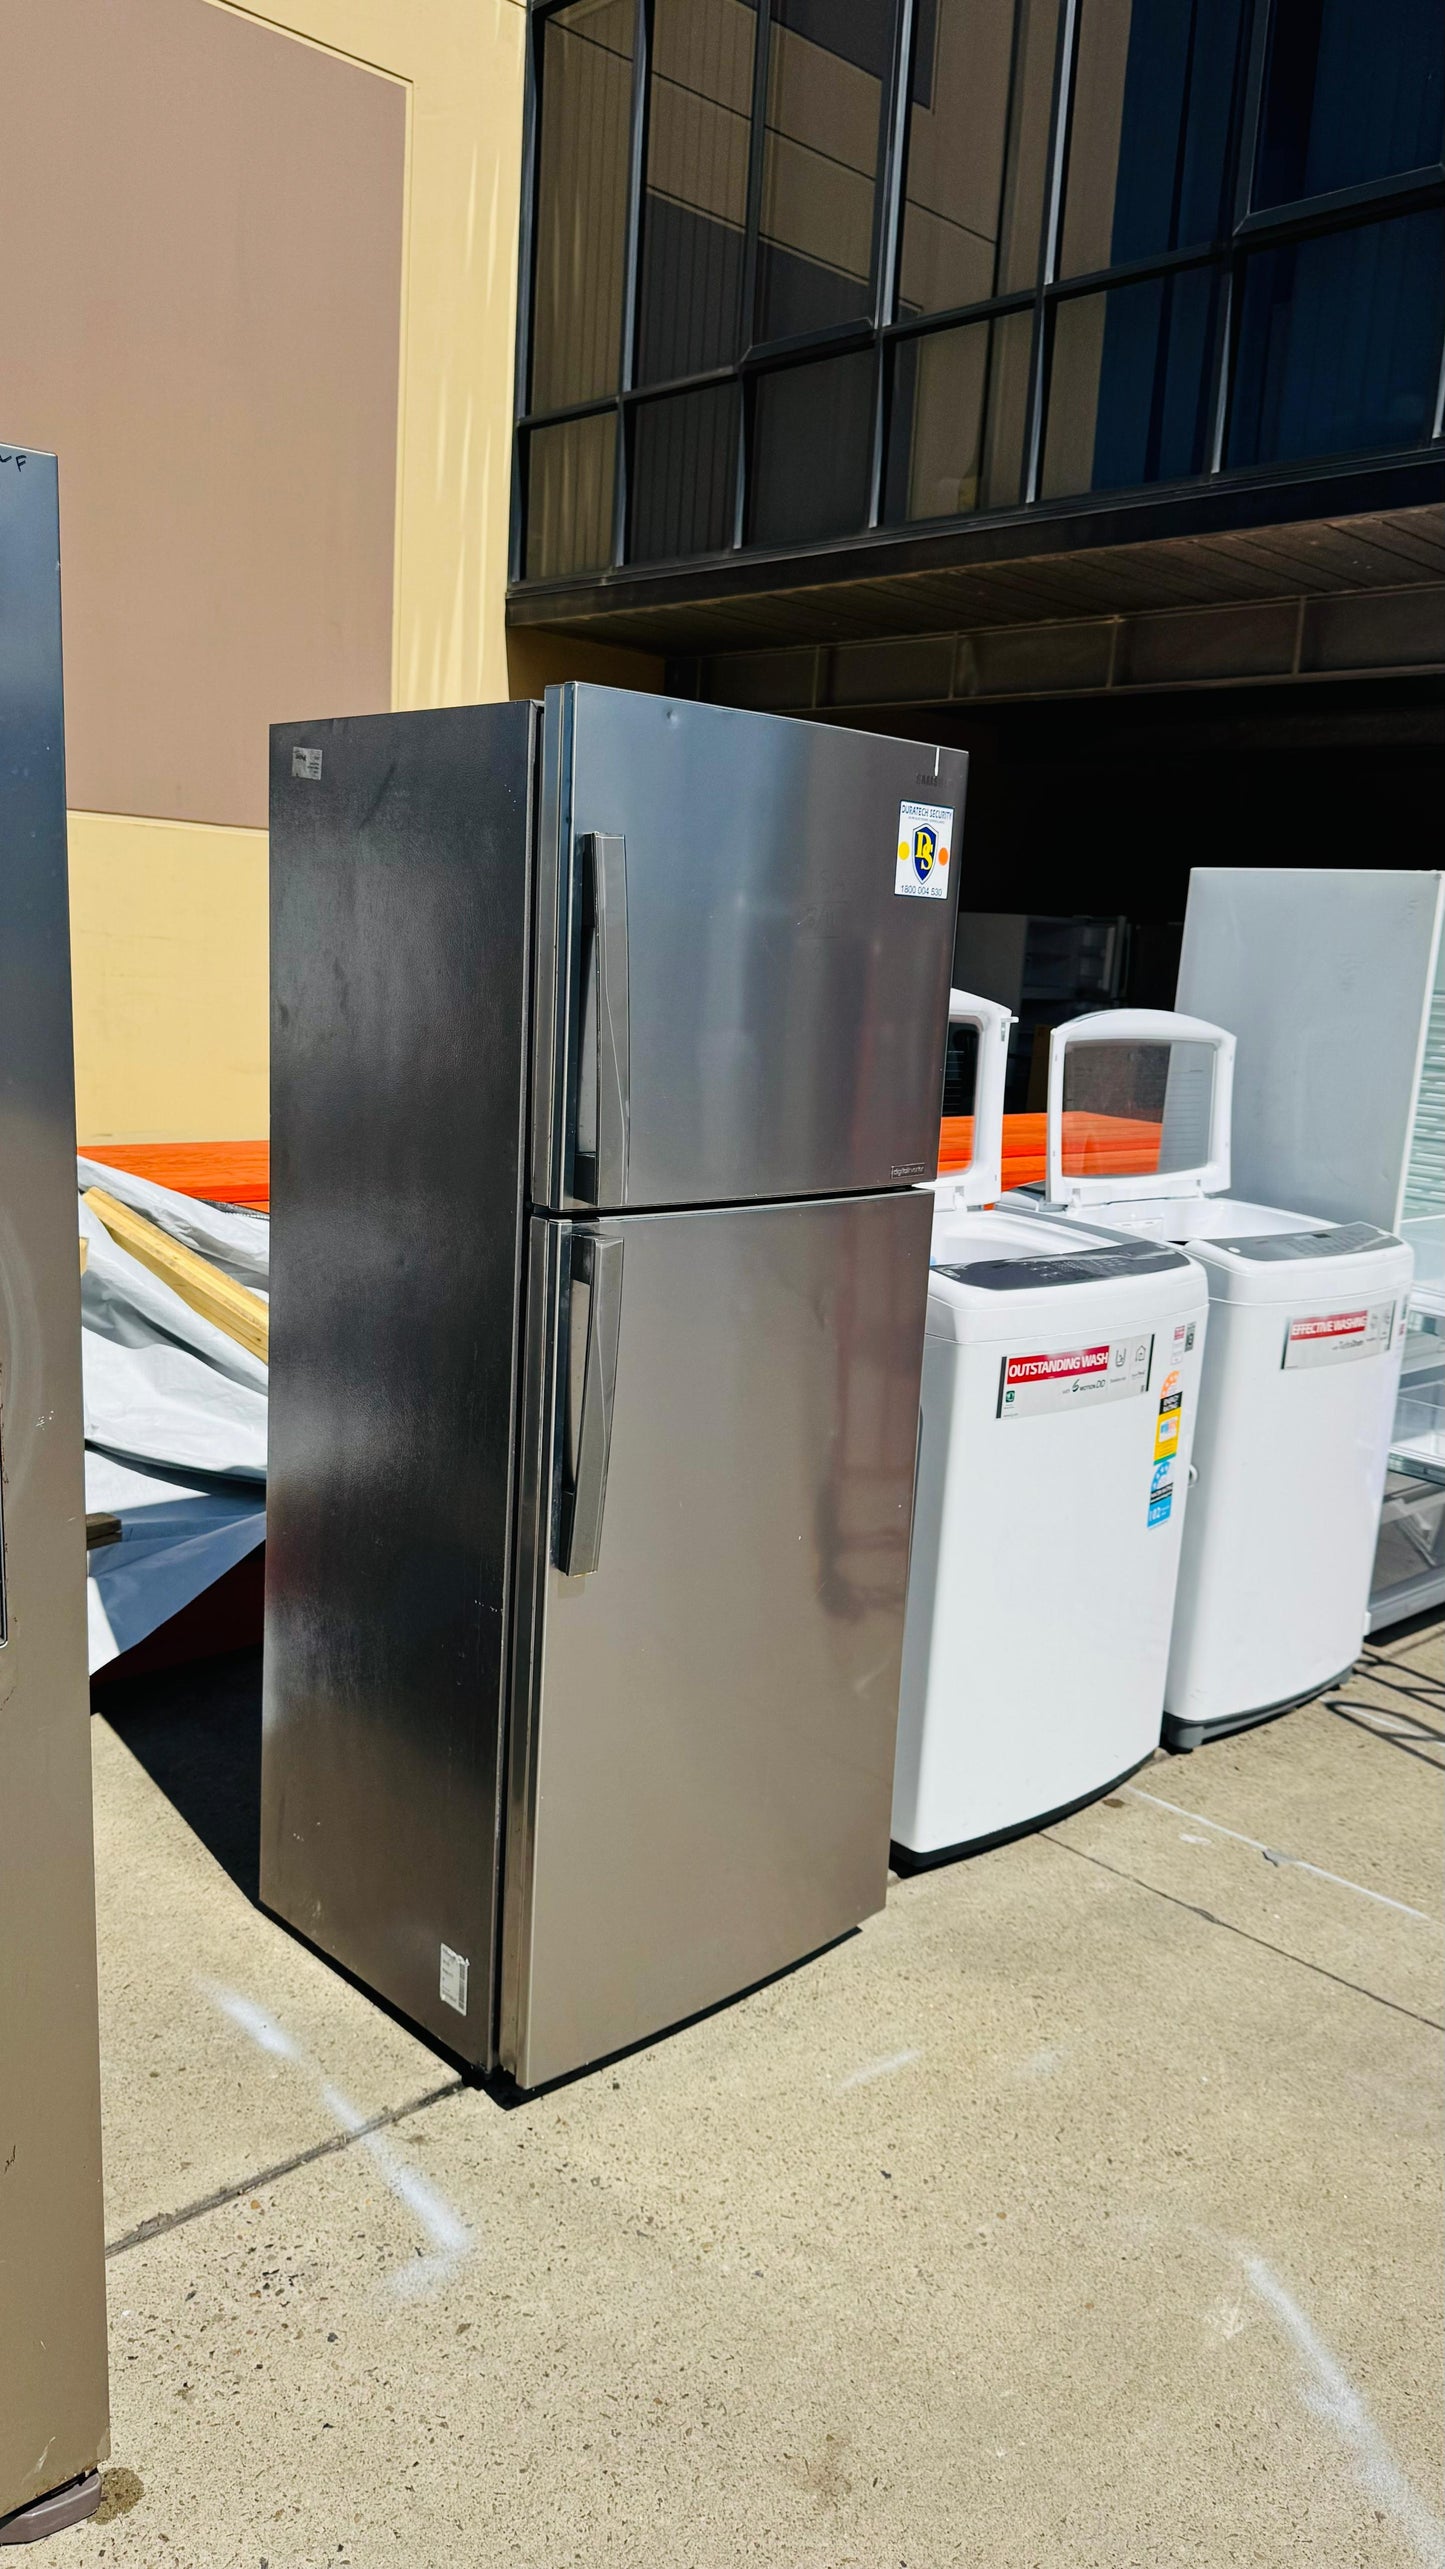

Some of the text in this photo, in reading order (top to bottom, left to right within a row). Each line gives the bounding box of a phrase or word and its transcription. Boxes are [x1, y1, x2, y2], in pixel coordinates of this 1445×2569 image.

[901, 805, 929, 817] DURATECH
[929, 809, 952, 821] SECURITY
[901, 885, 917, 895] 1800
[917, 886, 929, 896] 004
[1291, 1321, 1334, 1336] EFFECTIVE
[1009, 1351, 1109, 1377] OUTSTANDING WASH
